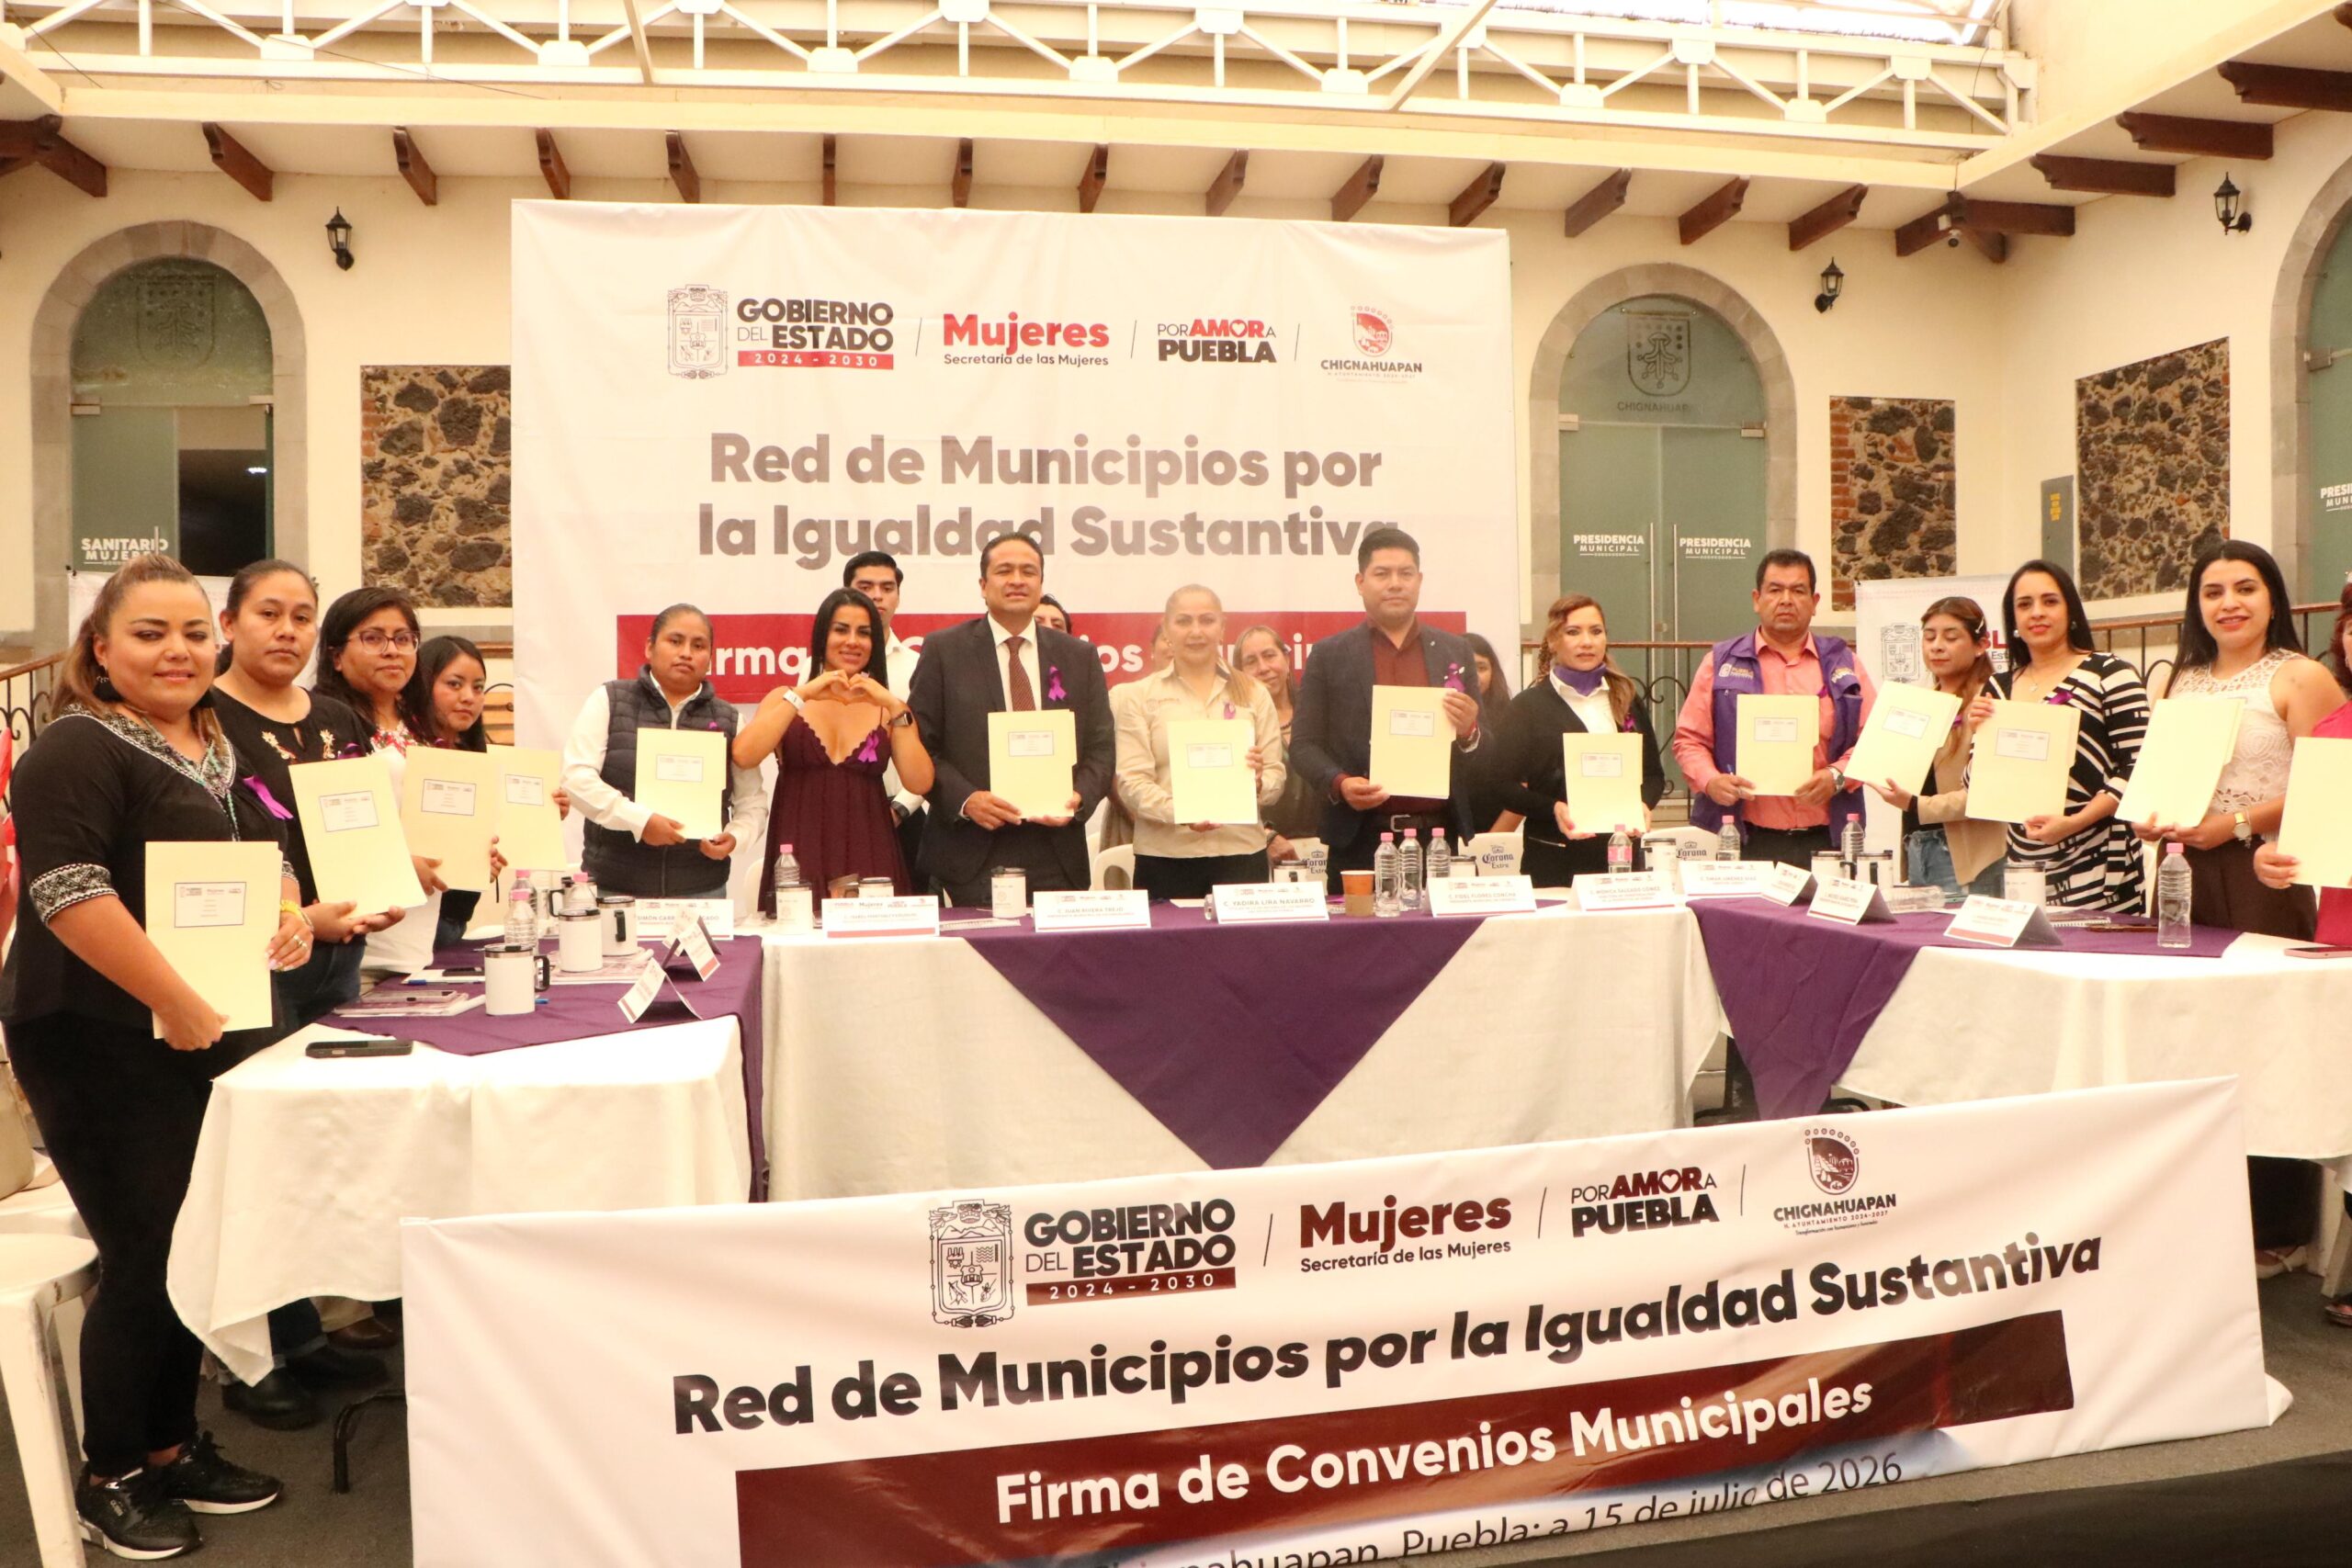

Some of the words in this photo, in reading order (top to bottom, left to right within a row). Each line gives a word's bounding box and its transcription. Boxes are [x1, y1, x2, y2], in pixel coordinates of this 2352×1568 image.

[737, 298, 894, 326] GOBIERNO
[738, 326, 769, 343] DEL
[772, 324, 894, 353] ESTADO
[943, 311, 1110, 355] Mujeres
[754, 353, 803, 366] 2024
[829, 354, 878, 367] 2030
[944, 354, 1012, 366] Secretaría
[1016, 354, 1034, 366] de
[1036, 353, 1055, 366] las
[1057, 355, 1110, 368] Mujeres
[1159, 339, 1278, 364] PUEBLA
[1320, 359, 1422, 373] CHIGNAHUAPAN
[711, 433, 830, 484] Red
[846, 434, 925, 485] de
[941, 433, 1269, 499] Municipios
[1284, 449, 1382, 500] por
[81, 537, 168, 551] SANITARIO
[699, 502, 756, 556] la
[1070, 505, 1398, 557] Sustantiv
[1573, 534, 1645, 545] PRESIDENCIA
[1679, 537, 1751, 548] PRESIDENCIA
[1685, 547, 1746, 556] MUNICIPAL
[1024, 1198, 1236, 1247] GOBIERNO
[1571, 1193, 1720, 1237] PUEBLA
[1773, 1193, 1896, 1223] CHIGNAHUAPAN
[1300, 1194, 1512, 1254] Mujeres
[1026, 1252, 1069, 1272] DEL
[1073, 1234, 1237, 1278] ESTADO
[1300, 1252, 1389, 1273] Secretaría
[1393, 1249, 1415, 1264] de
[1419, 1247, 1443, 1261] las
[1447, 1241, 1511, 1259] Mujeres
[1049, 1284, 1114, 1301] 2024
[1149, 1273, 1215, 1292] 2030
[673, 1365, 815, 1435] Red
[831, 1359, 922, 1420] de
[938, 1335, 1309, 1411] Municipios
[1326, 1328, 1437, 1389] por
[1451, 1311, 1510, 1359] la
[1525, 1269, 1797, 1364] Igualdad
[1810, 1232, 2102, 1315] Sustantiva
[996, 1470, 1160, 1524] Firma
[1178, 1454, 1250, 1505] de
[1266, 1421, 1556, 1494] Convenios
[1569, 1377, 1873, 1457] Municipales
[1549, 1518, 1568, 1535] a
[1585, 1503, 1623, 1530] 15
[1634, 1495, 1679, 1524] de
[1767, 1468, 1809, 1501] de
[1818, 1451, 1903, 1495] 2026
